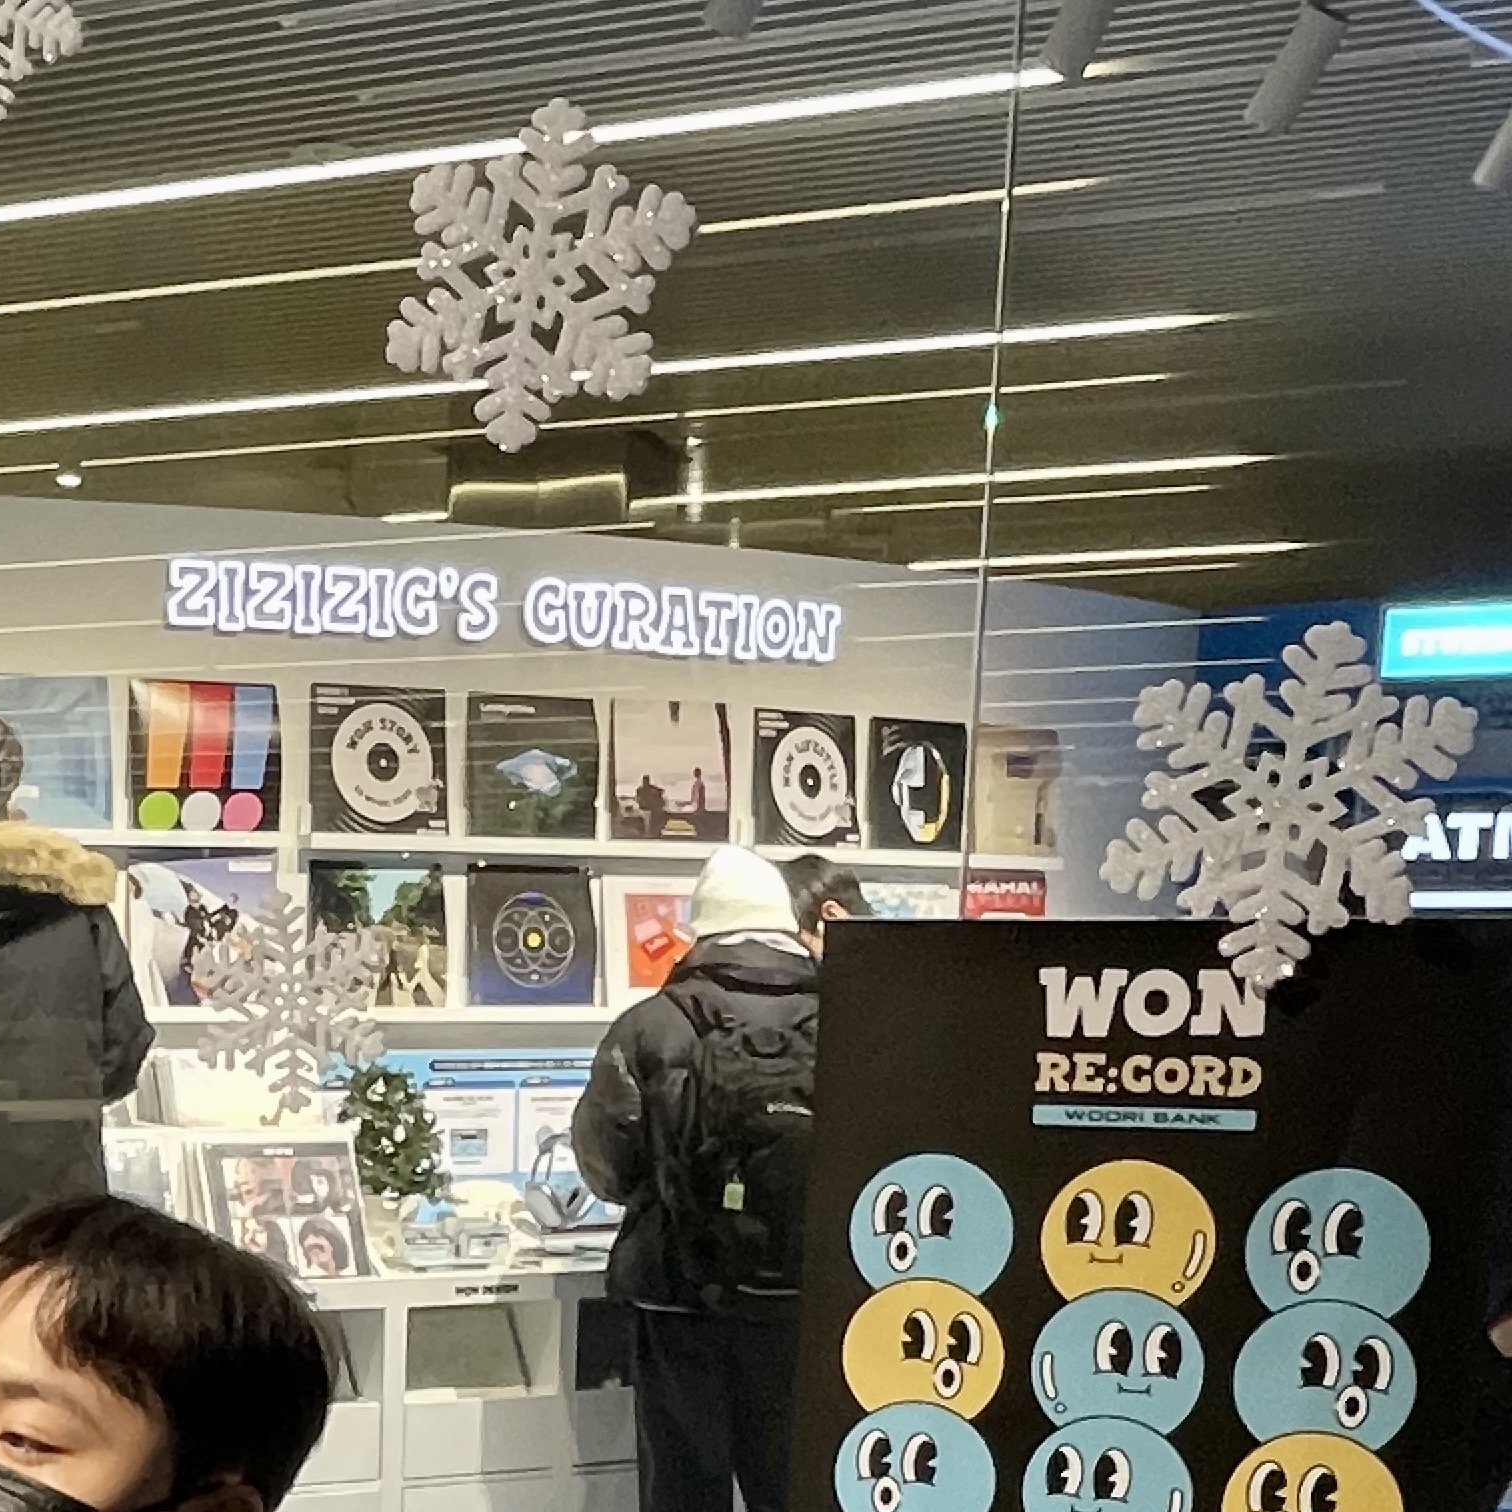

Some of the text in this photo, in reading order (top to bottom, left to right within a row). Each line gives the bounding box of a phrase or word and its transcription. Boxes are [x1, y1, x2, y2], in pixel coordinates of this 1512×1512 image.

[1039, 966, 1267, 1038] WON
[1034, 1051, 1263, 1098] RE:CORD
[1064, 1109, 1223, 1126] WOORI BANK
